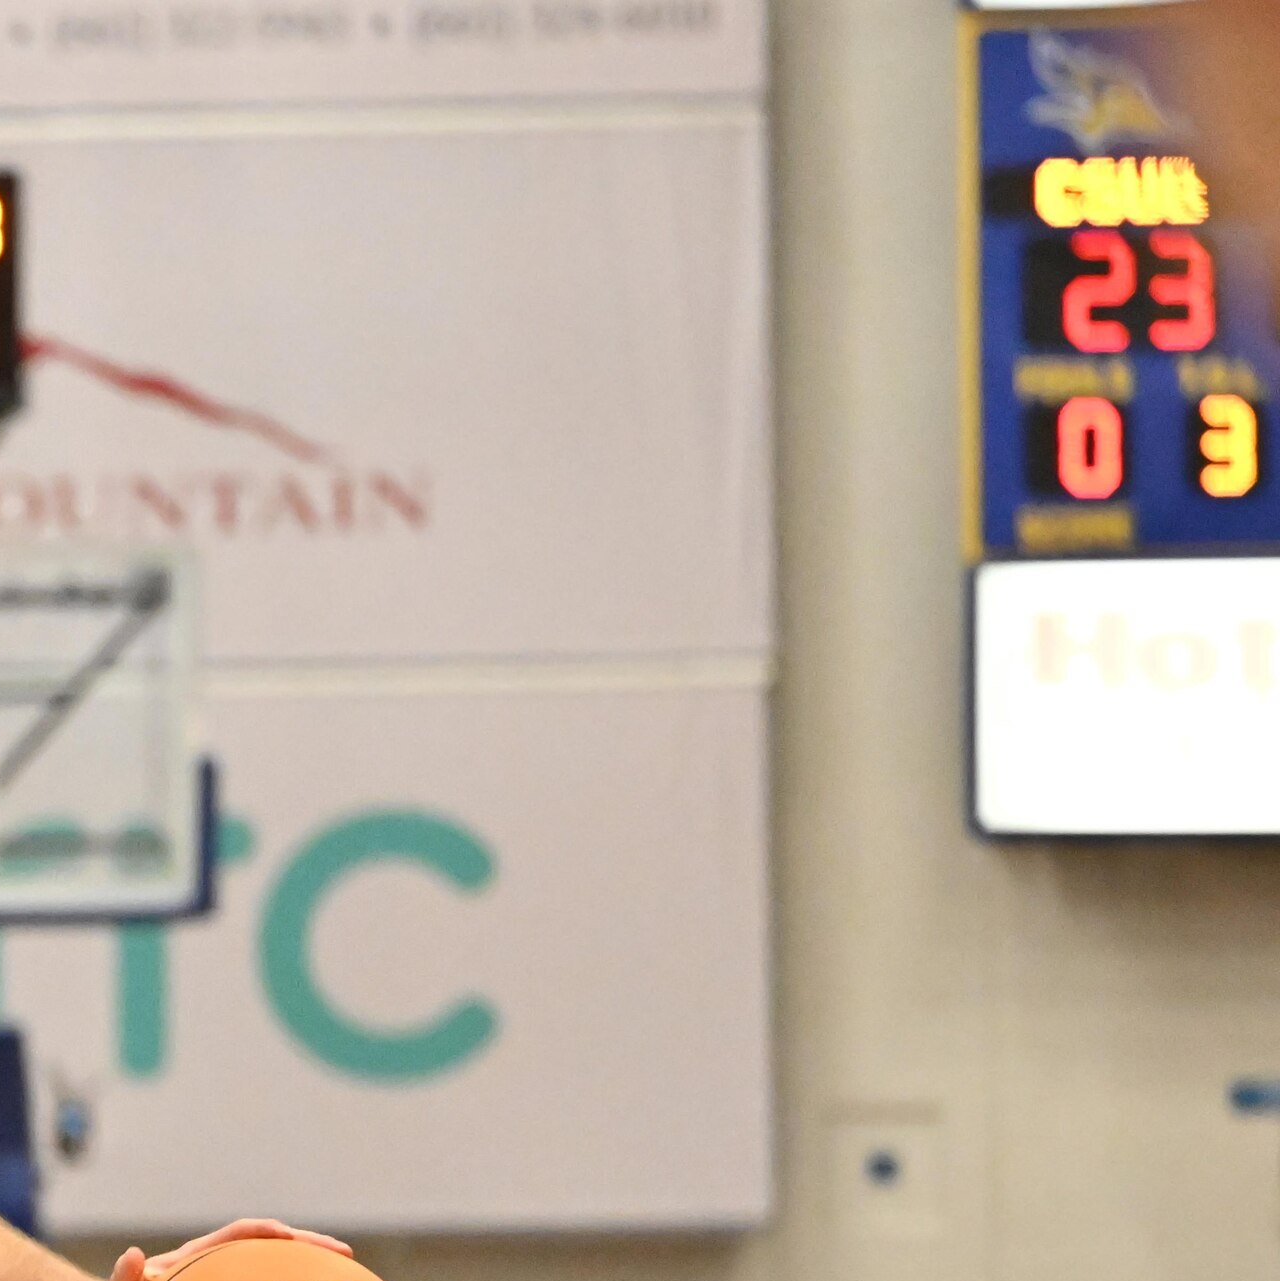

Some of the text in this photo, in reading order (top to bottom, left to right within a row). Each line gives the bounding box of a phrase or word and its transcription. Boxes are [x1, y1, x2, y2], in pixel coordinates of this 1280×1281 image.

[1062, 231, 1216, 353] 23
[1056, 395, 1123, 500] 0
[1197, 394, 1259, 499] 3
